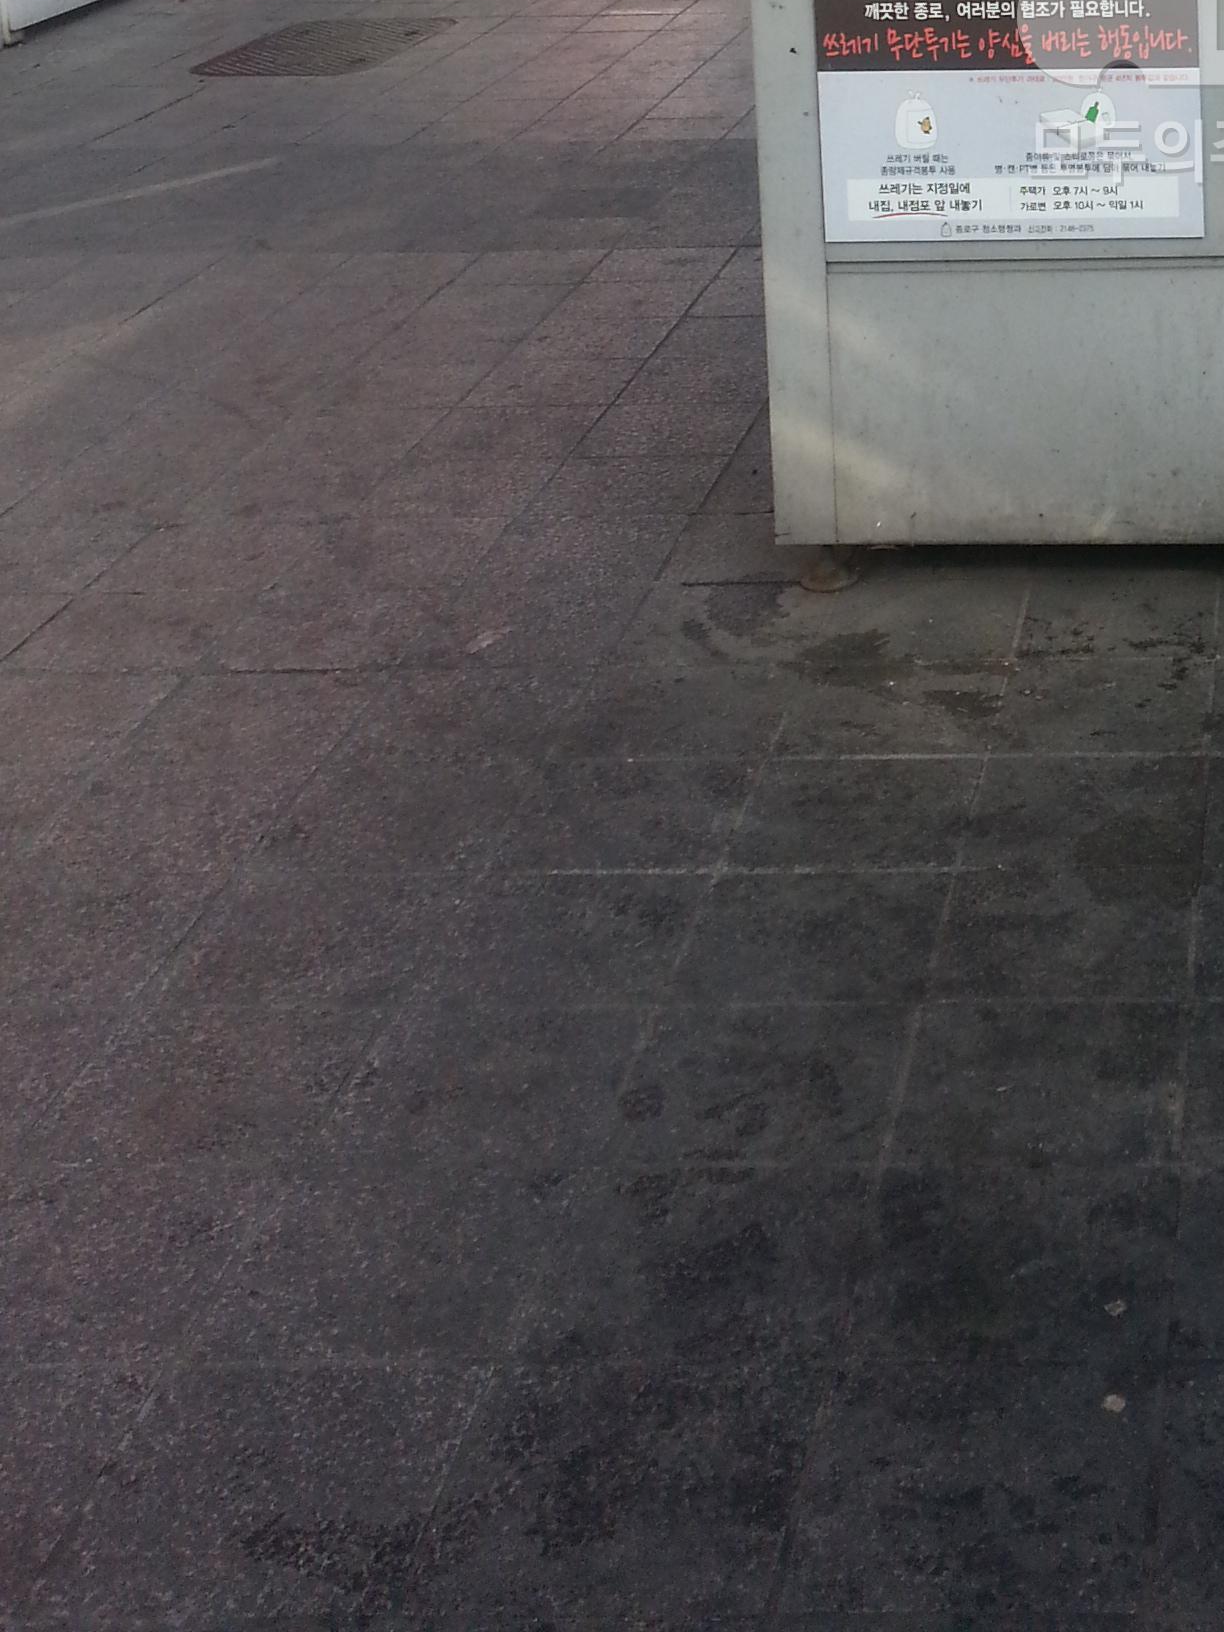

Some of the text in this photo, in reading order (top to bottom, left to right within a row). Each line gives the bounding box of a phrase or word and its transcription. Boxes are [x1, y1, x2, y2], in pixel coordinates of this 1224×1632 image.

[864, 0, 1151, 22] 깨끗한 종로, 여러분의 협조가 필요합니다.
[823, 24, 1192, 64] 쓰레기 무단투기는 양심을 버리는 행동입니다.
[879, 182, 970, 195] 쓰레기는 지정일에
[1020, 186, 1046, 196] 주택가
[1053, 186, 1070, 196] 오후
[1073, 186, 1088, 196] 7시
[1103, 186, 1118, 196] 9시
[898, 200, 931, 212] 내점포
[934, 199, 946, 212] 앞
[1020, 202, 1046, 212] 가로변
[1053, 201, 1070, 210] 오후
[1074, 201, 1094, 211] 10시
[1131, 200, 1143, 210] 1시
